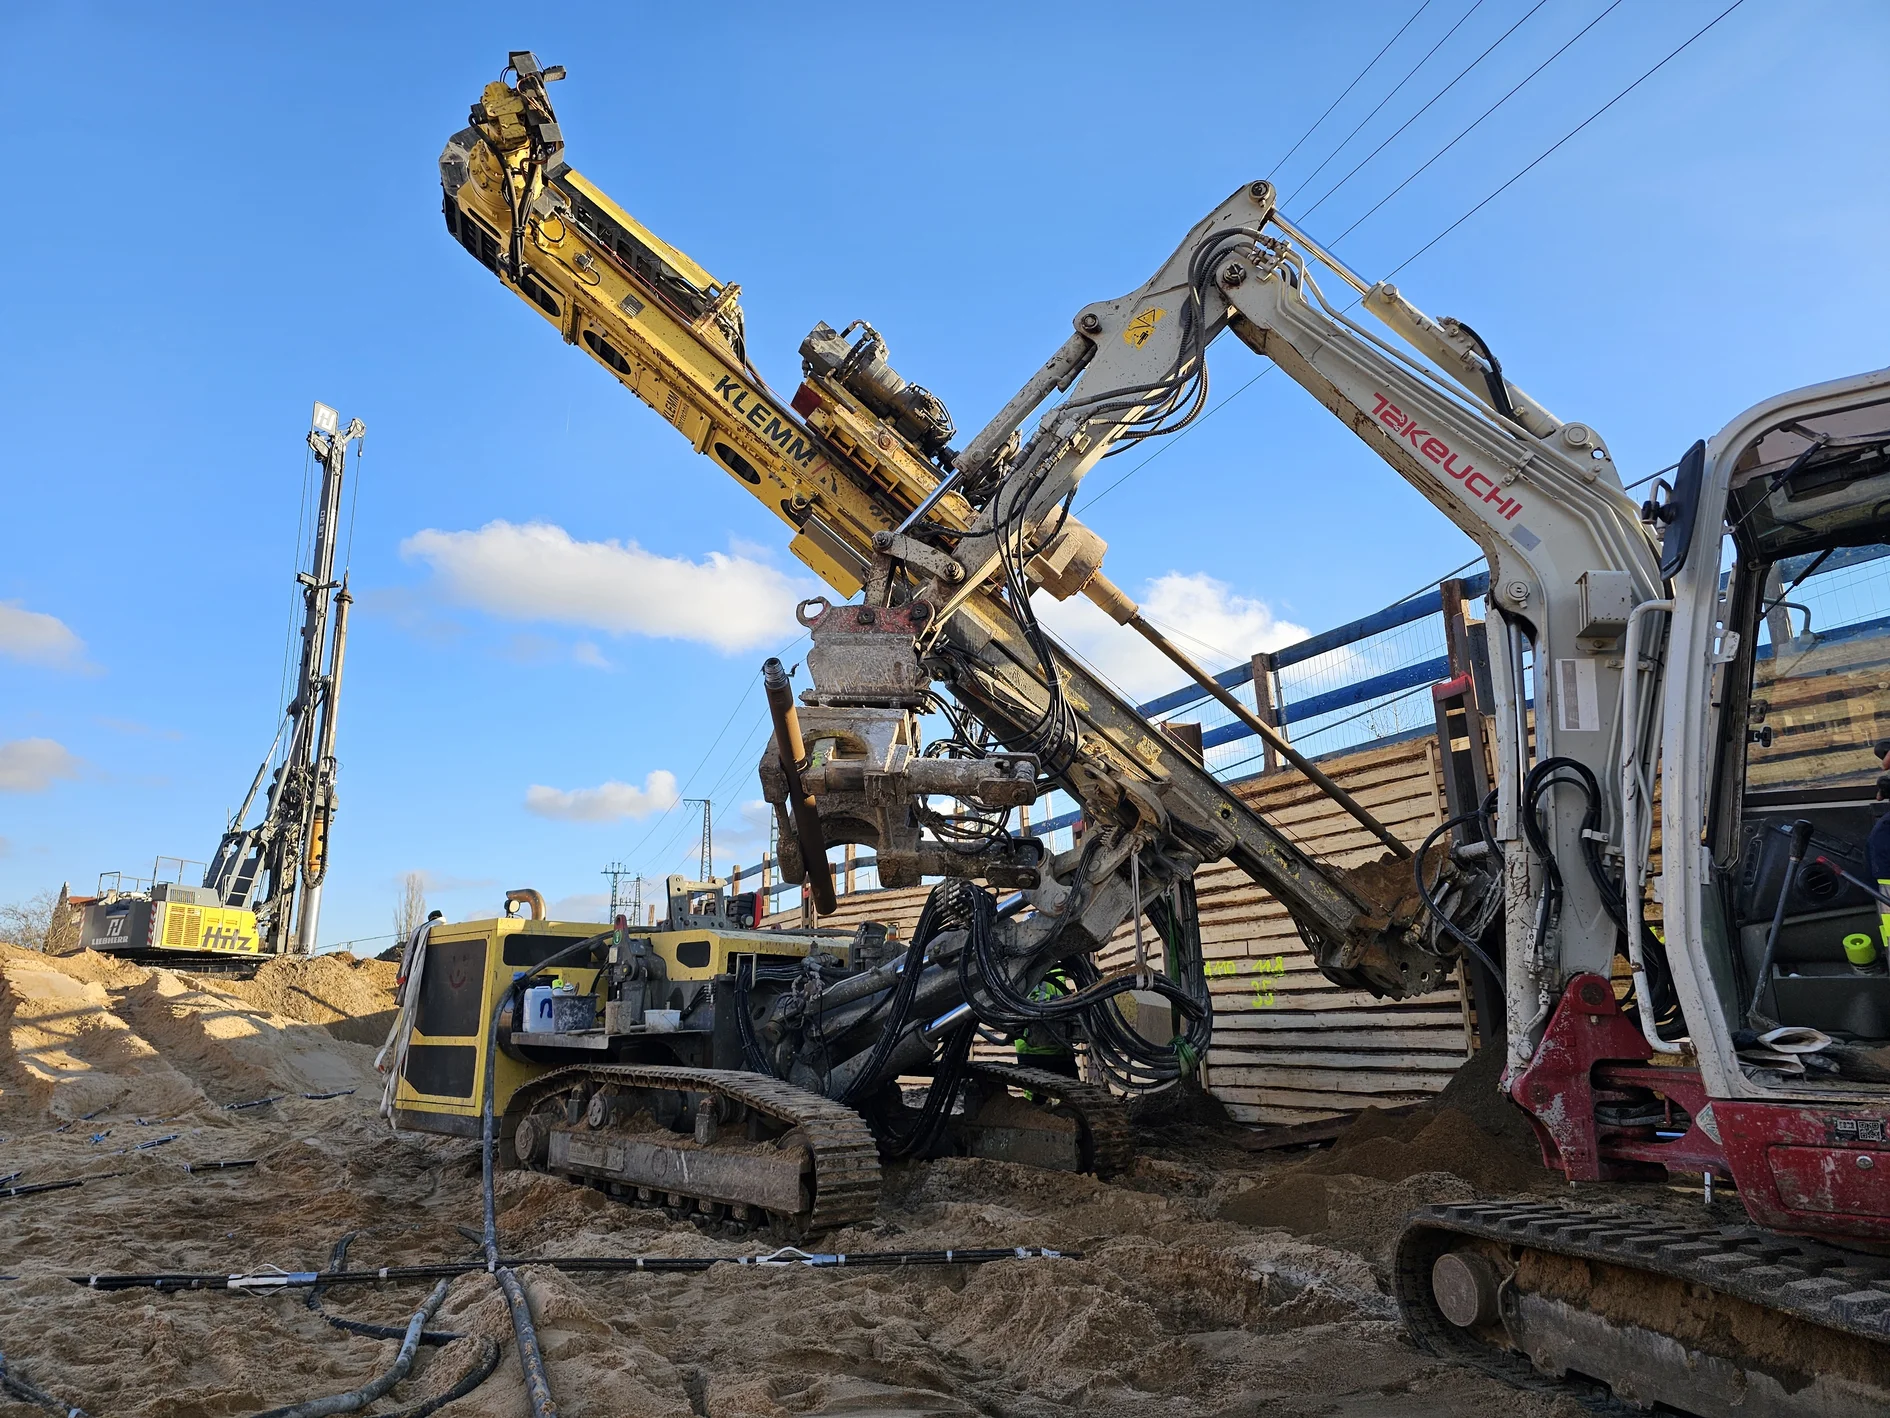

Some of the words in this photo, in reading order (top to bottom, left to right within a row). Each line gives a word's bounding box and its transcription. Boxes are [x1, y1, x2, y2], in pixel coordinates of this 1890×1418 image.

[662, 389, 681, 424] KLEMM
[713, 374, 818, 468] KLEMM
[91, 935, 129, 946] LIEBHERR
